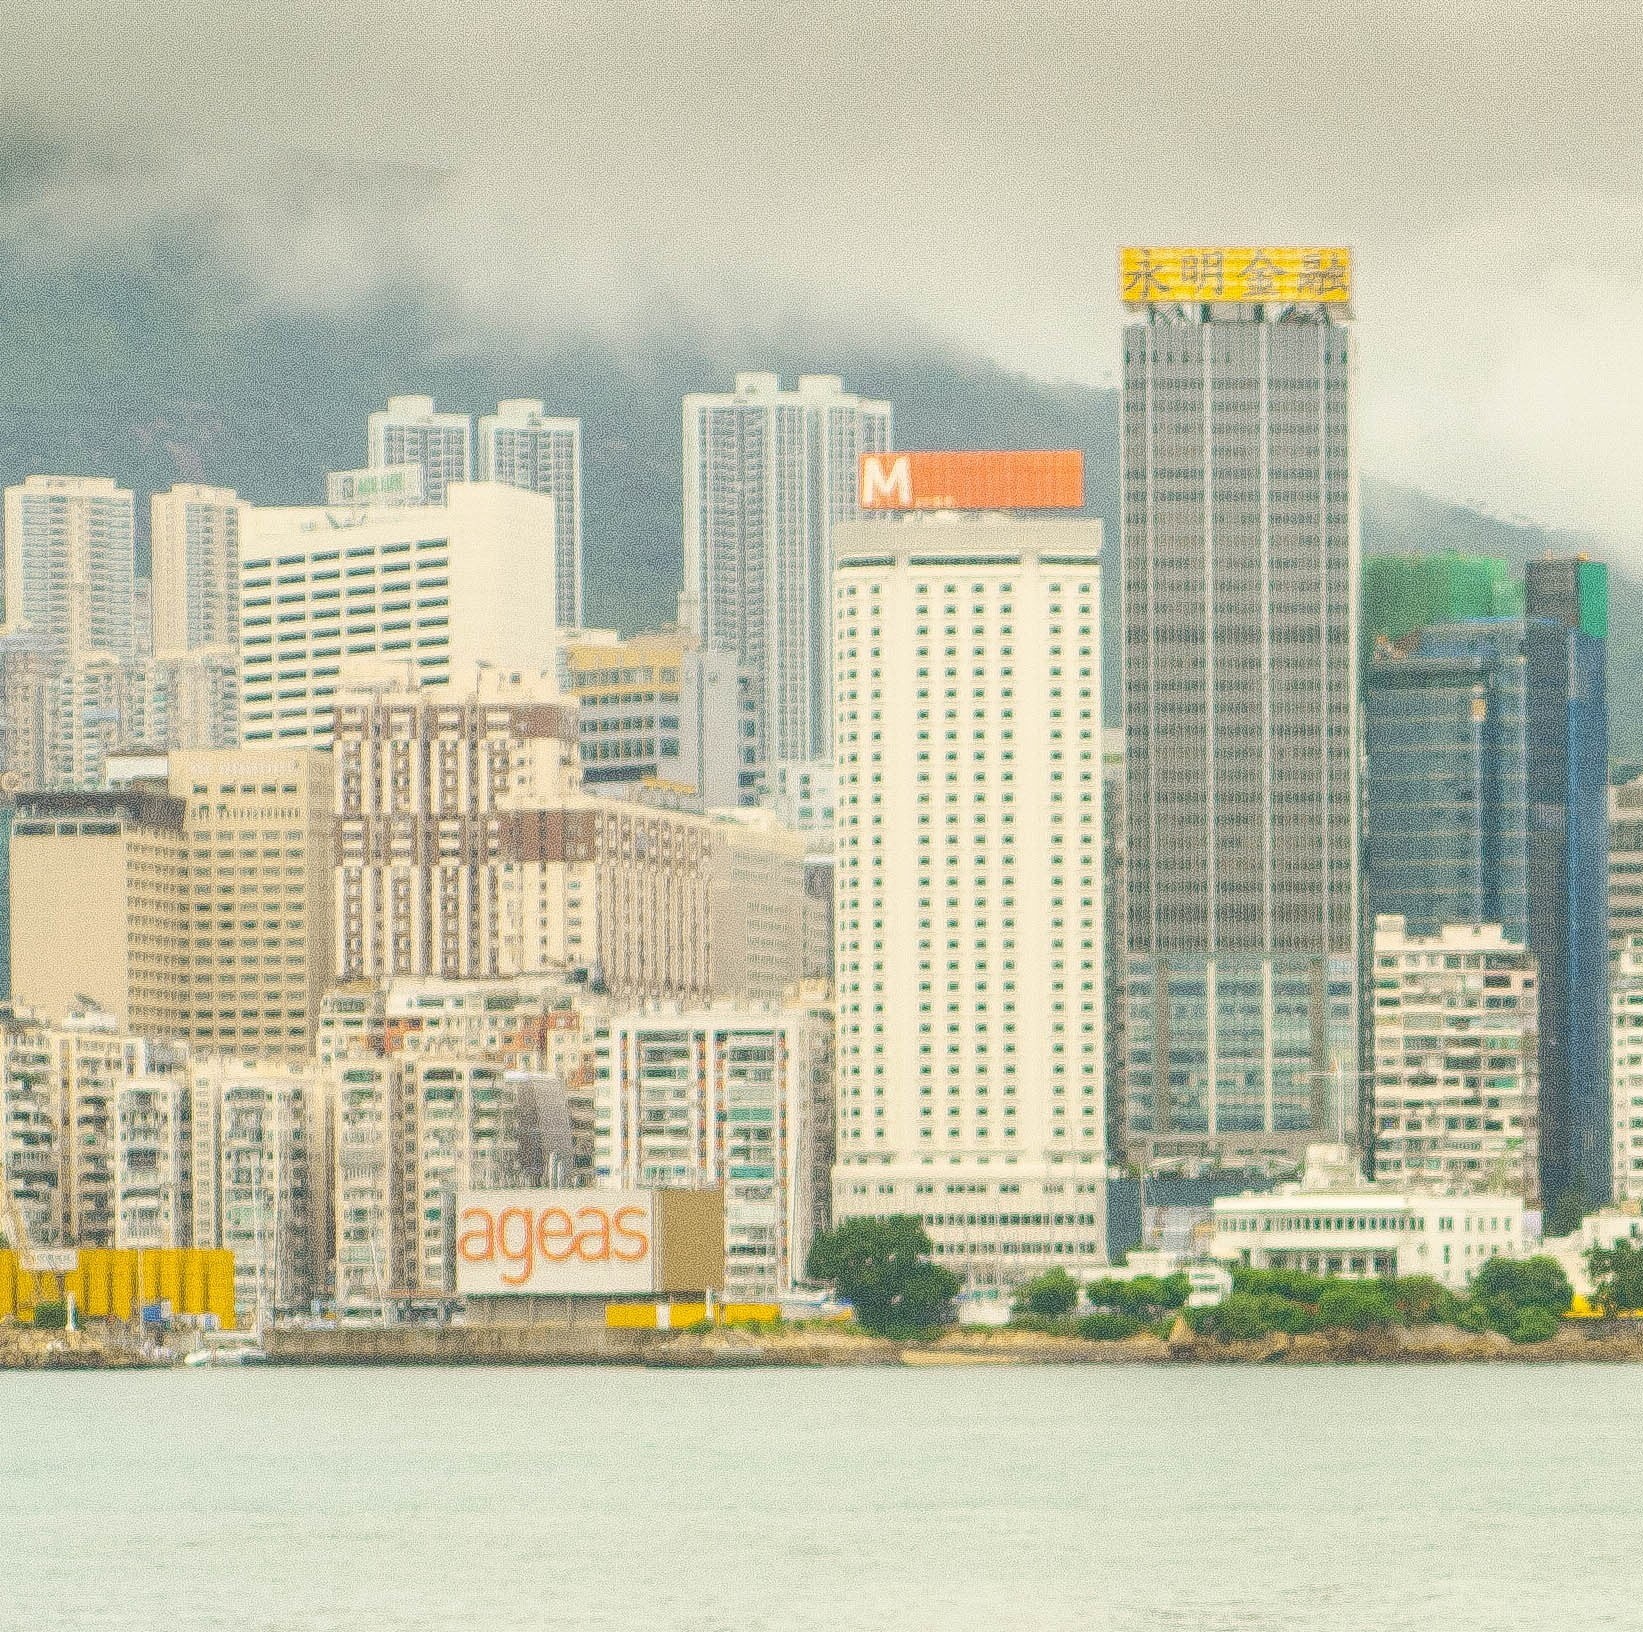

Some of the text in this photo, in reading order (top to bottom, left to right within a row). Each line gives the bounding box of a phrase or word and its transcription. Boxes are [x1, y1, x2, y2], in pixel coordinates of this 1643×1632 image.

[1125, 248, 1348, 299] 永明金融
[863, 457, 912, 505] M
[459, 1206, 649, 1285] ageas
